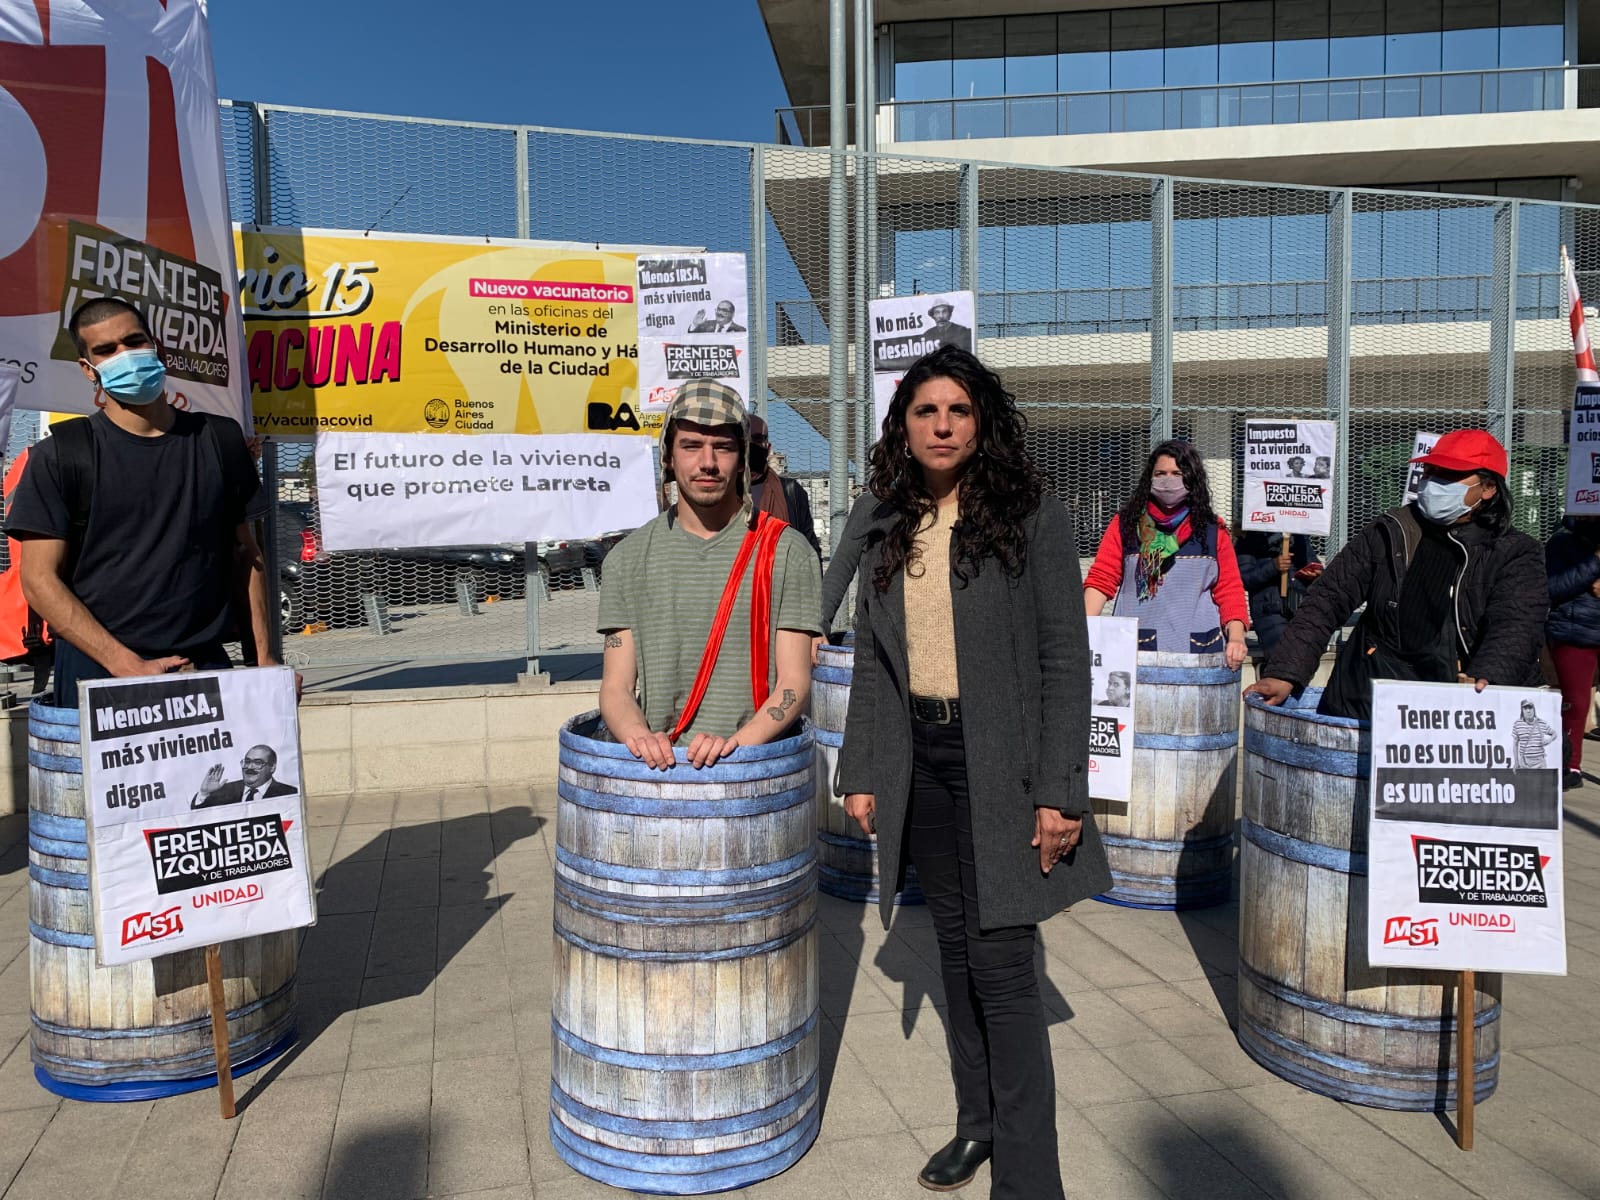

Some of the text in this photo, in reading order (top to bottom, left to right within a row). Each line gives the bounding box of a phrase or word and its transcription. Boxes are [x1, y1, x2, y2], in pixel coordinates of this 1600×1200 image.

[72, 235, 219, 316] FRENTE DE
[238, 245, 378, 316] rio 15
[641, 267, 704, 285] Menos IRSA,
[473, 281, 629, 301] Nuevo vacunatorio
[644, 288, 711, 305] más vivienda
[488, 303, 614, 319] en las oficinas del
[646, 313, 675, 328] digna
[63, 286, 227, 359] IUIERDA
[495, 320, 608, 338] Ministerio de
[876, 312, 923, 333] No más
[247, 321, 402, 392] ACUNA
[424, 337, 639, 359] Desarrollo Humano y Há
[667, 346, 733, 359] FRENTE DE
[165, 353, 228, 378] RABAJADORES
[500, 360, 610, 377] de la Ciudad
[668, 358, 737, 372] IZQUIERDA
[454, 399, 494, 409] Buenos
[454, 410, 484, 419] Aires
[251, 412, 373, 428] ar/vacunacovid
[455, 420, 494, 430] Ciudad
[587, 402, 640, 431] BA
[1578, 414, 1584, 424] a
[1249, 428, 1295, 441] Impuesto
[1250, 443, 1311, 455] a la vivienda
[334, 450, 621, 471] El futuro de la vivienda
[1251, 459, 1281, 471] ociosa
[347, 475, 611, 501] que promete Larreta
[1267, 485, 1319, 495] FRENTE DE
[1267, 493, 1322, 503] IZQUIERDA
[1279, 509, 1307, 517] UNIDAD
[96, 692, 218, 733] Menos IRSA,
[1398, 704, 1497, 731] Tener casa
[101, 727, 233, 770] más vivienda
[1386, 739, 1511, 769] no es un lujo,
[105, 780, 166, 809] digna
[1383, 777, 1516, 804] es un derecho
[153, 820, 278, 859] FRENTE DE
[155, 836, 288, 880] IZQUIERDA
[1419, 844, 1535, 870] FRENTE DE
[201, 857, 290, 882] Y DE TRABAJADORES
[1419, 866, 1544, 893] IZQUIERDA
[192, 883, 259, 910] UNIDAD
[1459, 892, 1545, 904] Y DE TRABAJADORES
[123, 909, 182, 942] MST
[1449, 912, 1511, 928] UNIDAD
[1386, 919, 1439, 944] MST
